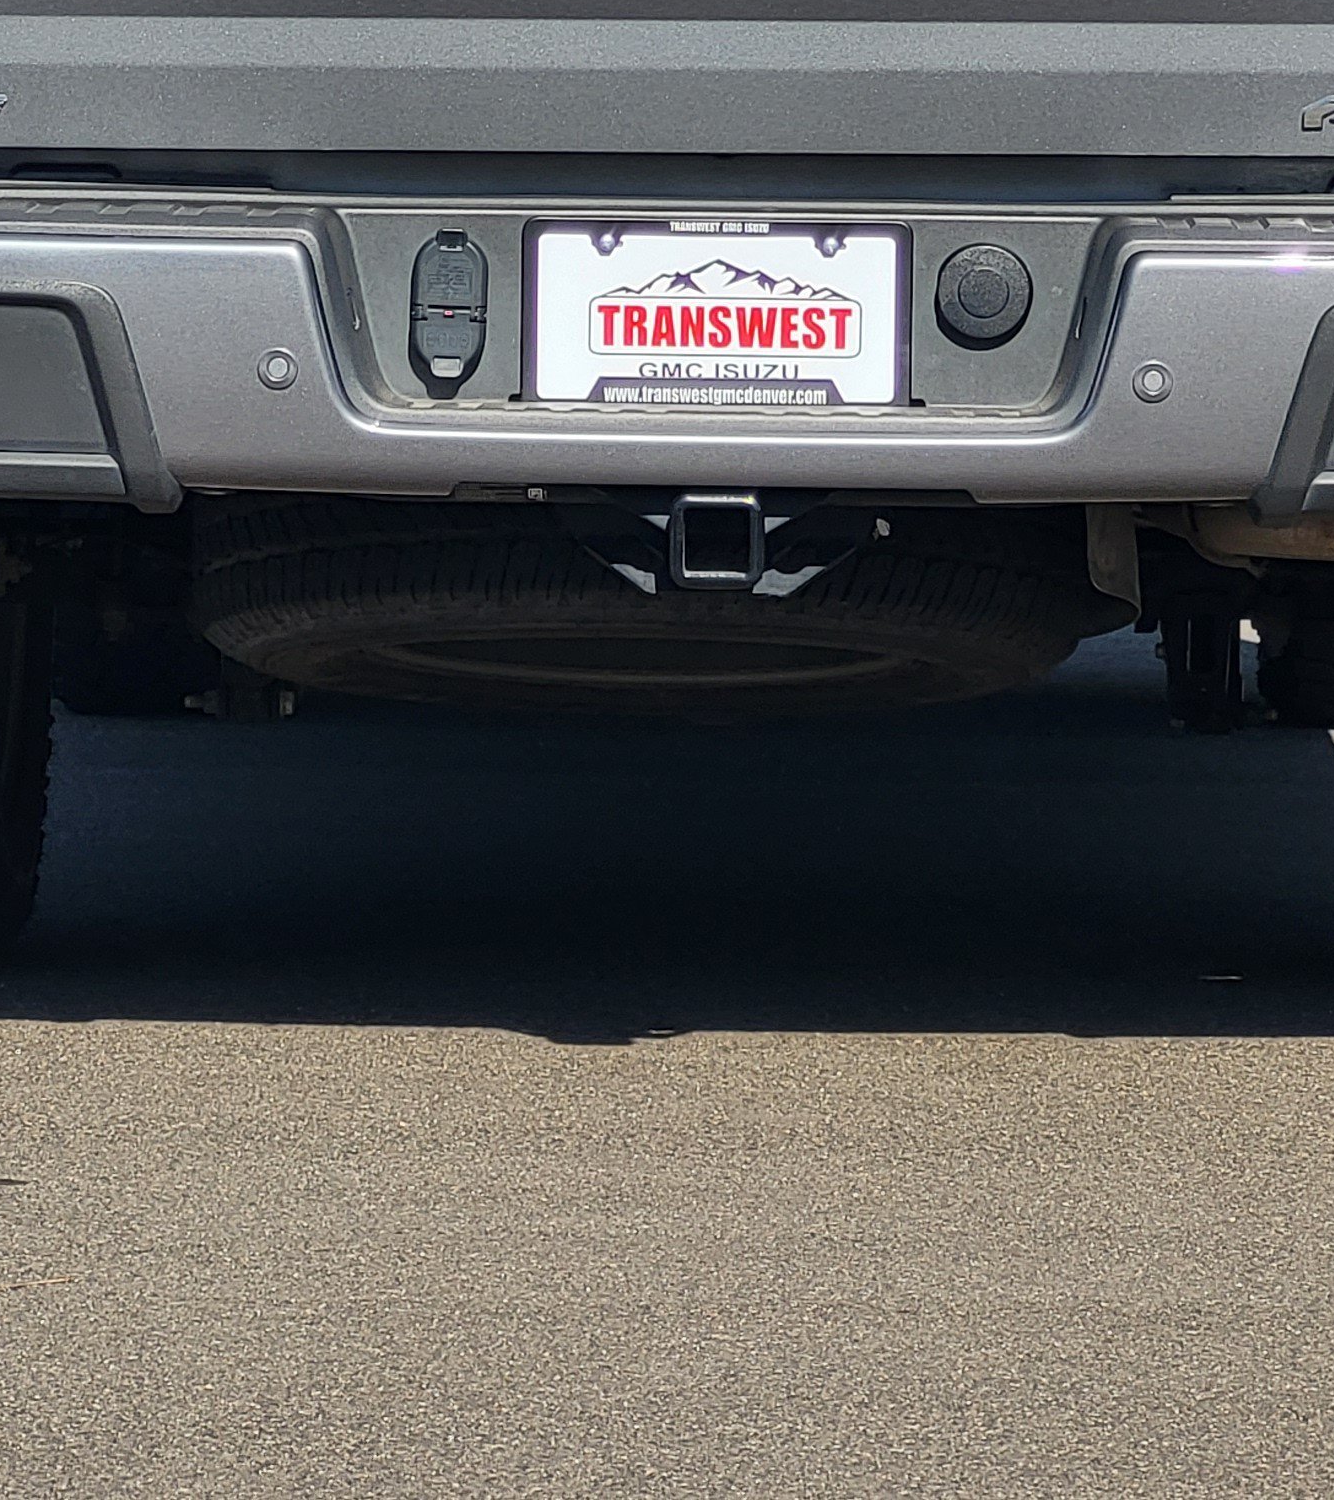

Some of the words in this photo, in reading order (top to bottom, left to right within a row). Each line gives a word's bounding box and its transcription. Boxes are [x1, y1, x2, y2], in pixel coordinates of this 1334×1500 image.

[669, 221, 721, 233] TRANSWEST
[597, 304, 853, 350] TRANSWEST
[638, 362, 704, 379] GMC
[715, 363, 800, 380] ISUZU
[603, 386, 828, 406] www.transwestgmcdenver.com
